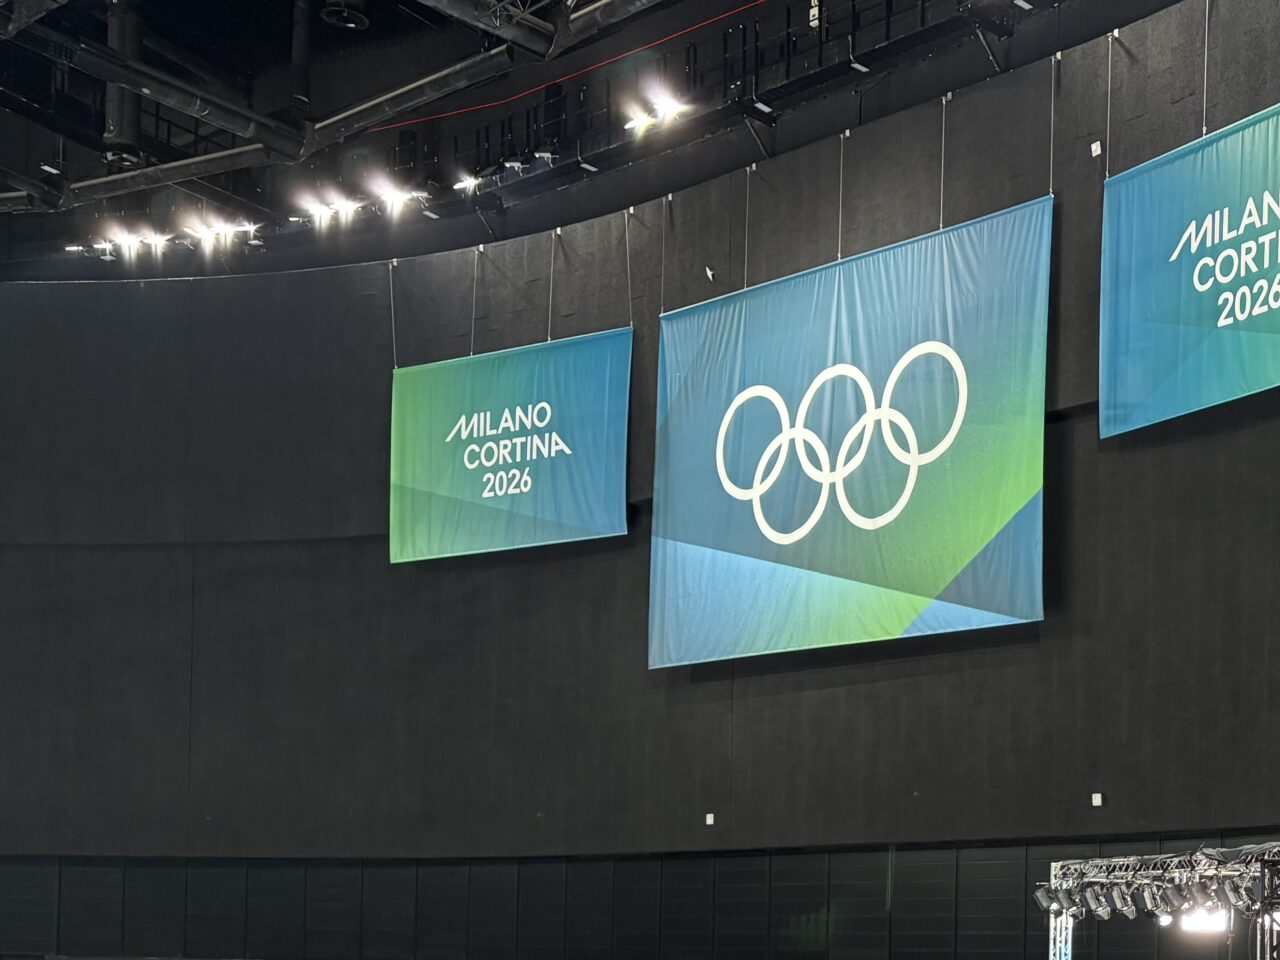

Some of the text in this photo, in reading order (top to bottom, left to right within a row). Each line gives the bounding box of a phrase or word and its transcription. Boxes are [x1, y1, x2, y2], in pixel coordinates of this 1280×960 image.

[445, 401, 552, 442] MILANO
[463, 431, 573, 470] CORTINA
[481, 467, 532, 498] 2026
